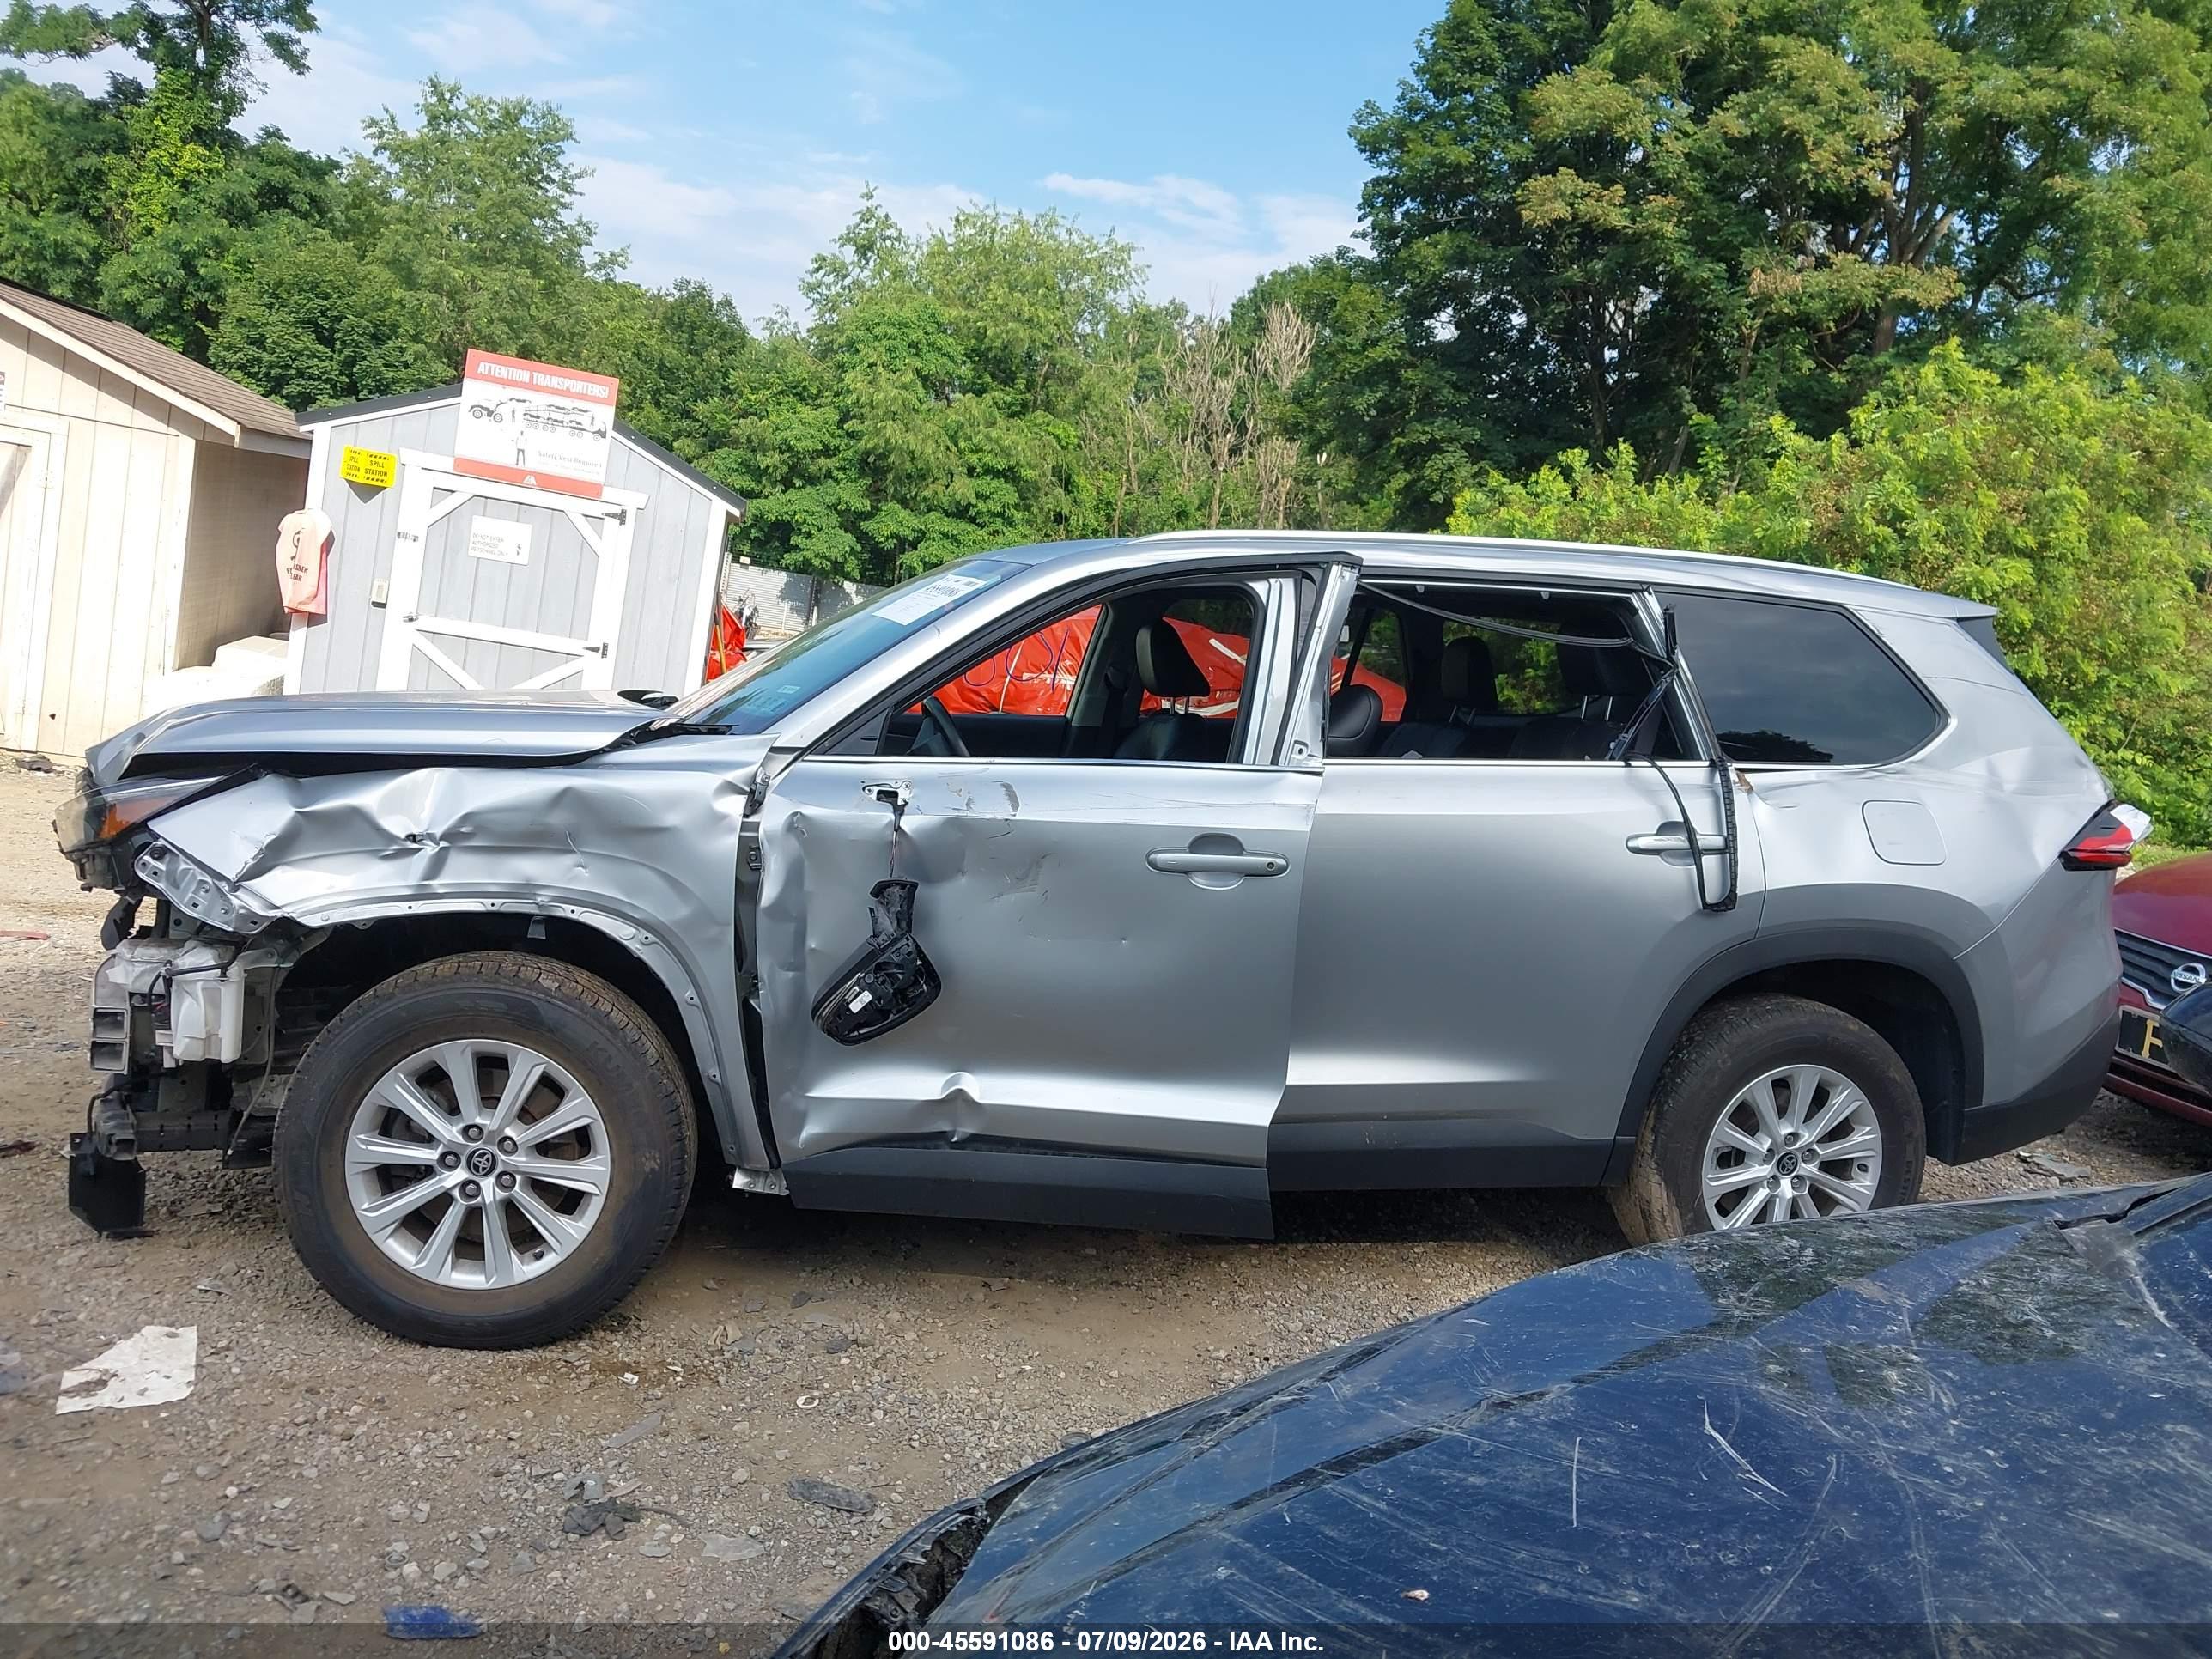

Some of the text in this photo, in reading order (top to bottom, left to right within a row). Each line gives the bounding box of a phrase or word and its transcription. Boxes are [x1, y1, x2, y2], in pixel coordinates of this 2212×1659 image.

[477, 362, 610, 398] ATTENTION TRANSPORTERS!
[369, 459, 385, 469] SPILL
[364, 468, 388, 477] STATION
